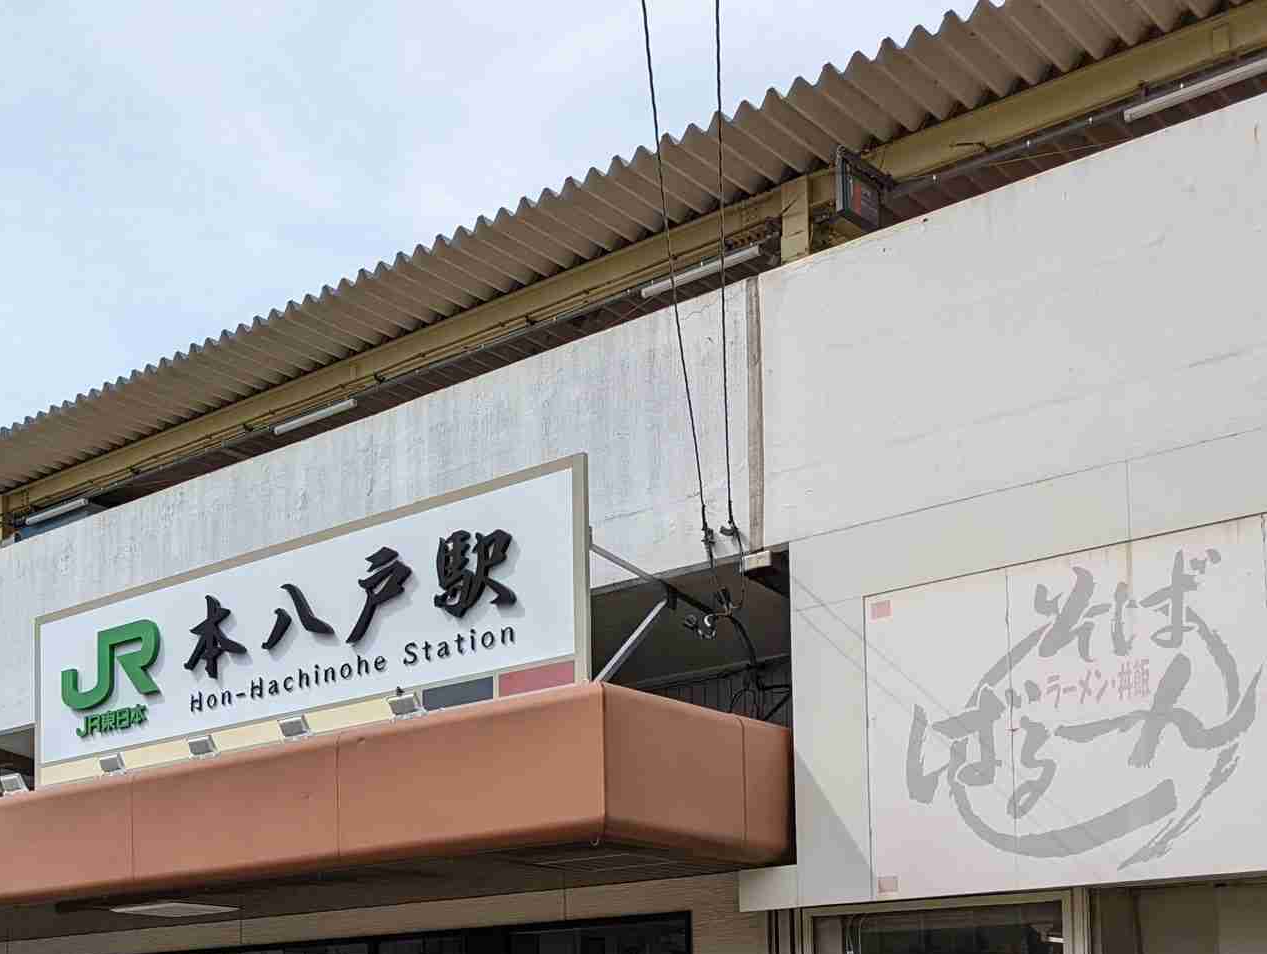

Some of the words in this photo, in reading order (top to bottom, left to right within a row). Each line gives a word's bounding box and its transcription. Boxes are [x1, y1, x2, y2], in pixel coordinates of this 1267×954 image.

[183, 528, 517, 680] 本八戸駅
[60, 618, 163, 710] JR
[189, 653, 388, 713] Hon-Hachinohe
[402, 622, 517, 667] Station
[76, 703, 149, 738] JR東日本
